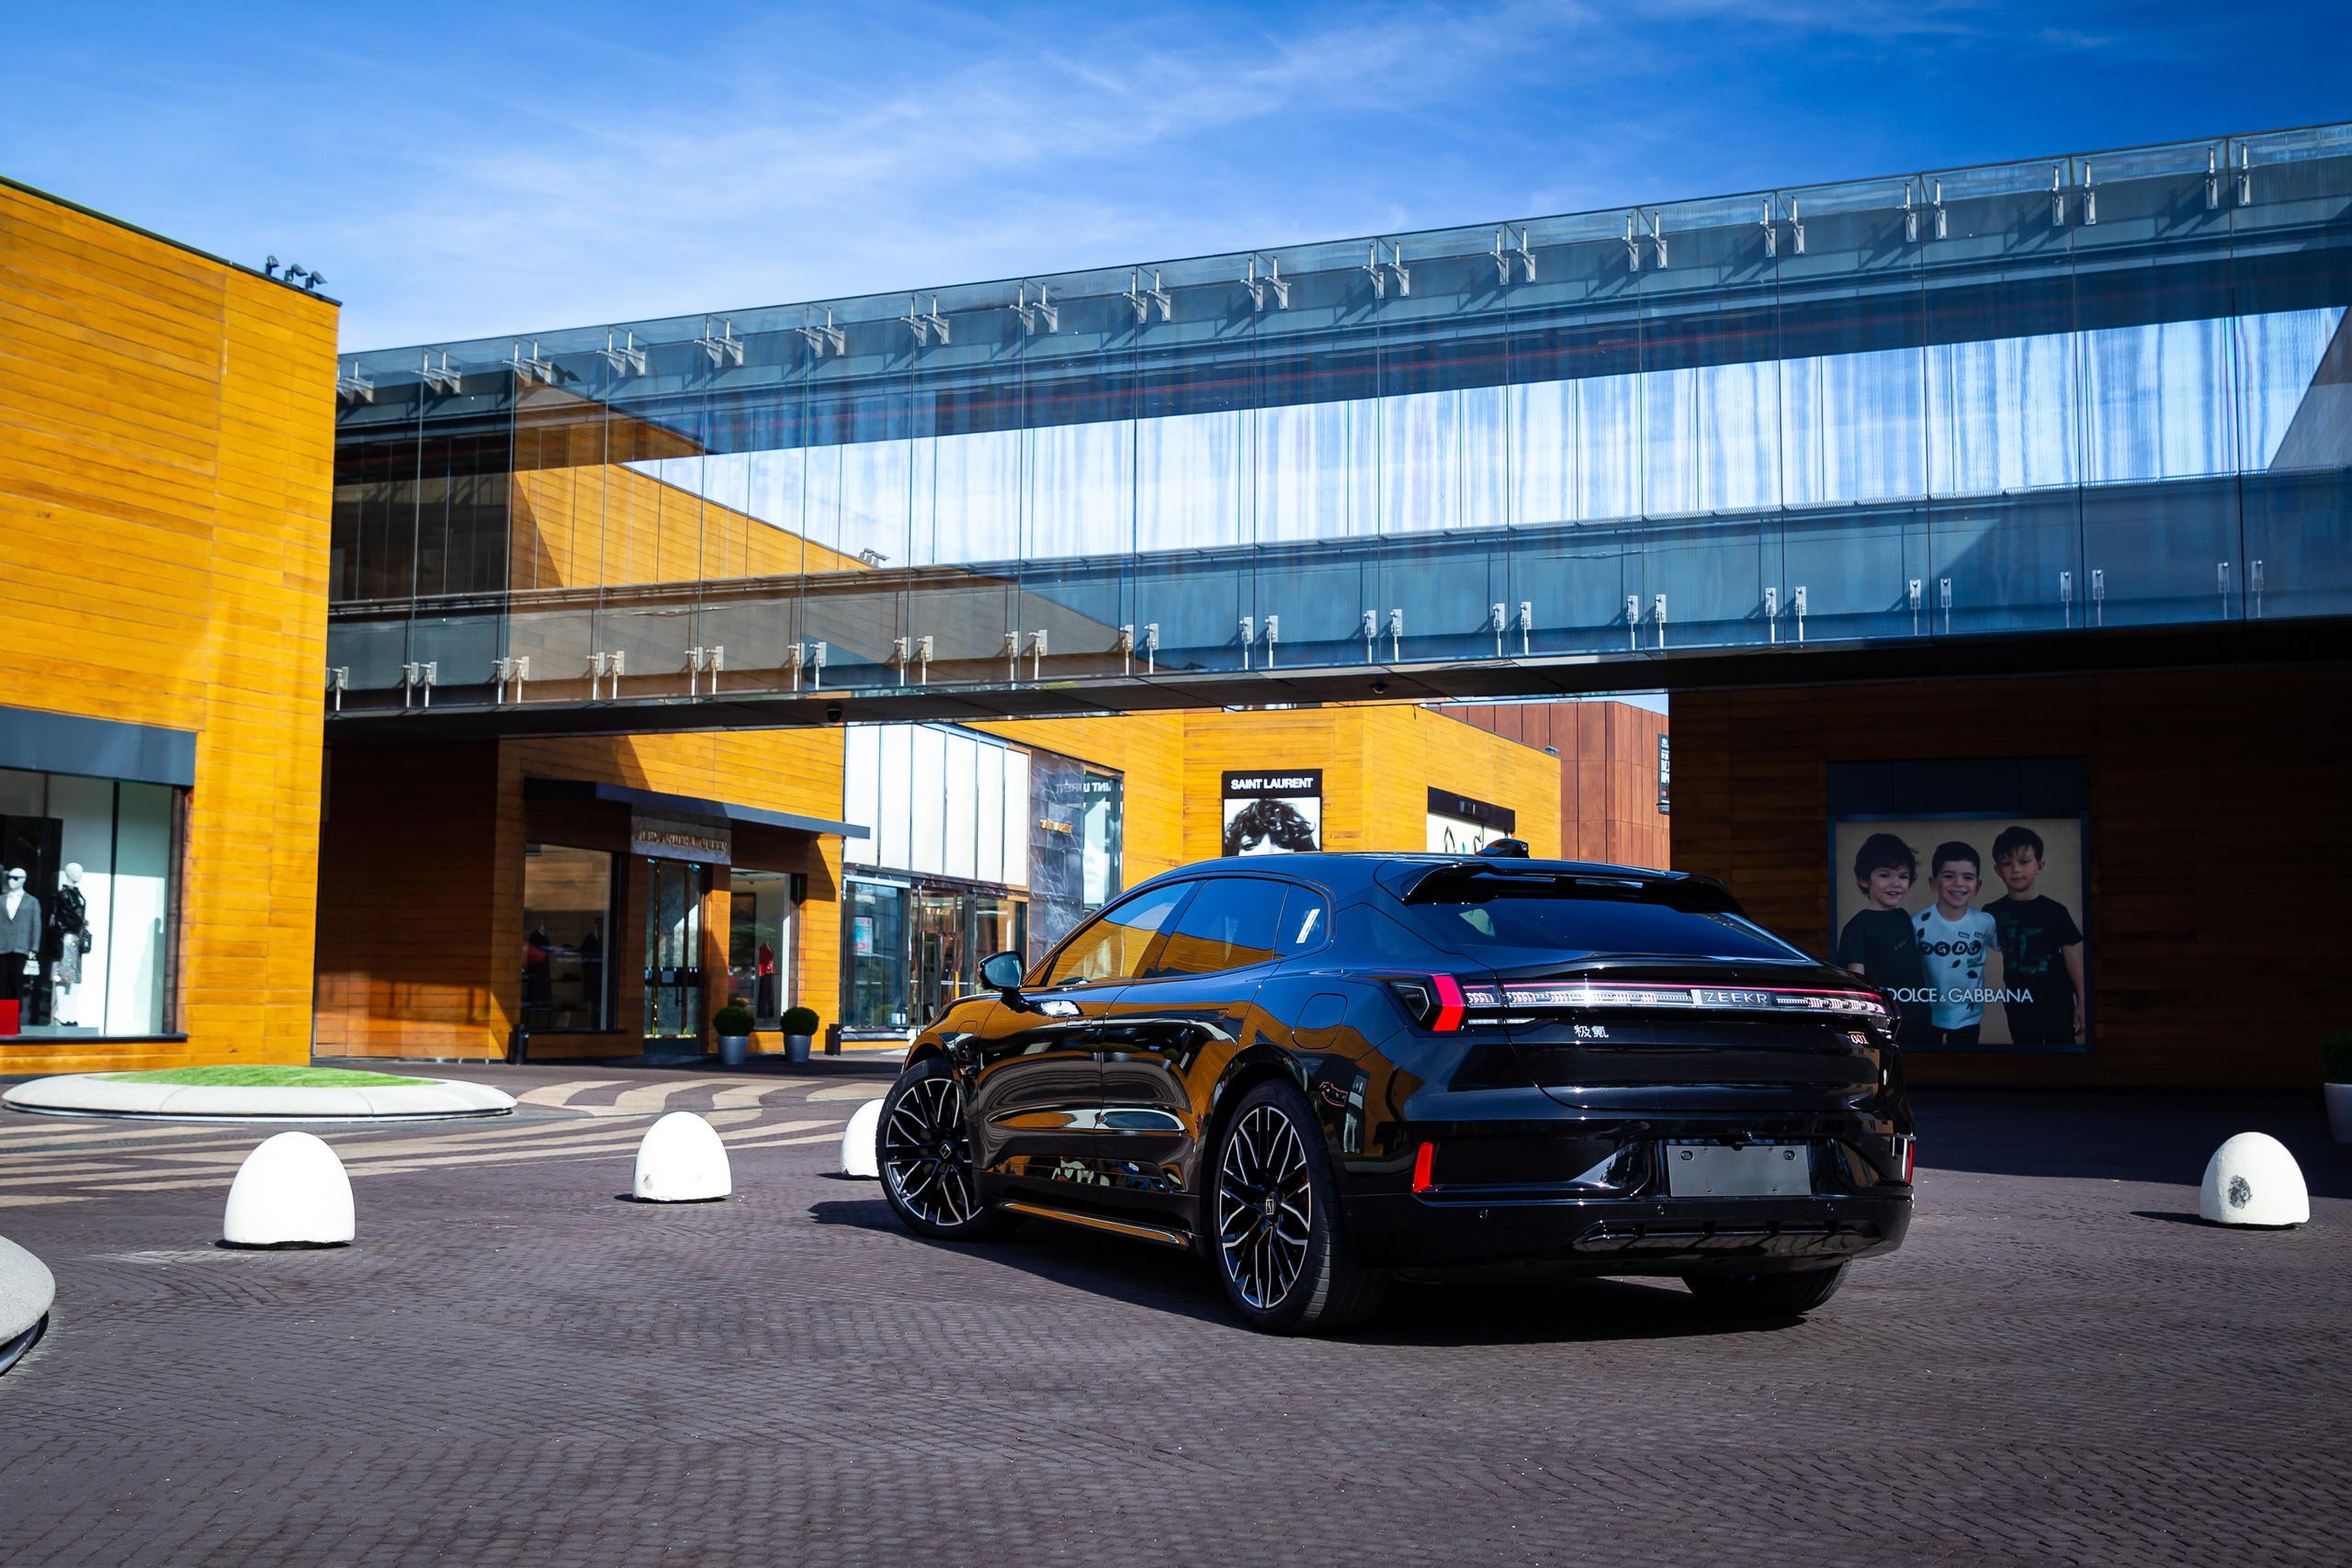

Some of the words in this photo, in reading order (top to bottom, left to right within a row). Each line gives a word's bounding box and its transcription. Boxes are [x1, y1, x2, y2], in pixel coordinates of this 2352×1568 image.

[1231, 779, 1262, 790] SAINT
[1263, 777, 1314, 789] LAURENT
[1703, 991, 1769, 1004] ZEEKR
[1948, 987, 2034, 1004] GABBANA
[1849, 1033, 1870, 1044] 001
